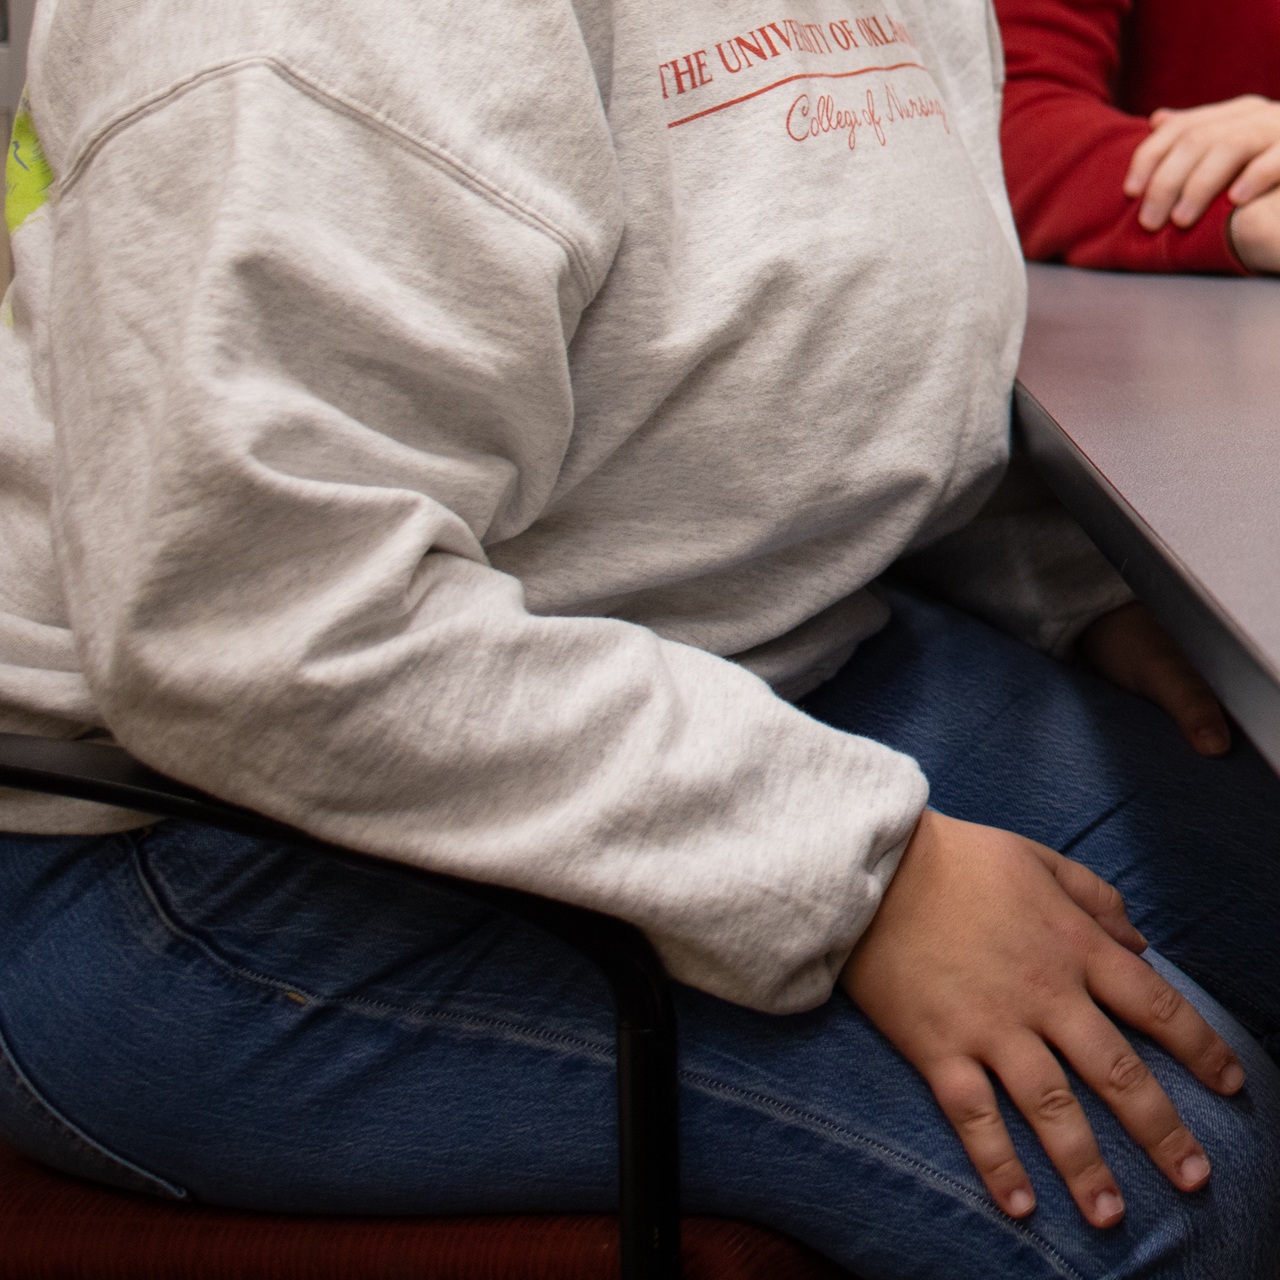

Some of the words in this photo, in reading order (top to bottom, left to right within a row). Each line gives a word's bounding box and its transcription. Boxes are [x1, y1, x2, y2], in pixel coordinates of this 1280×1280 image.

[659, 49, 713, 100] THE
[829, 19, 859, 51] OF
[861, 89, 886, 147] of
